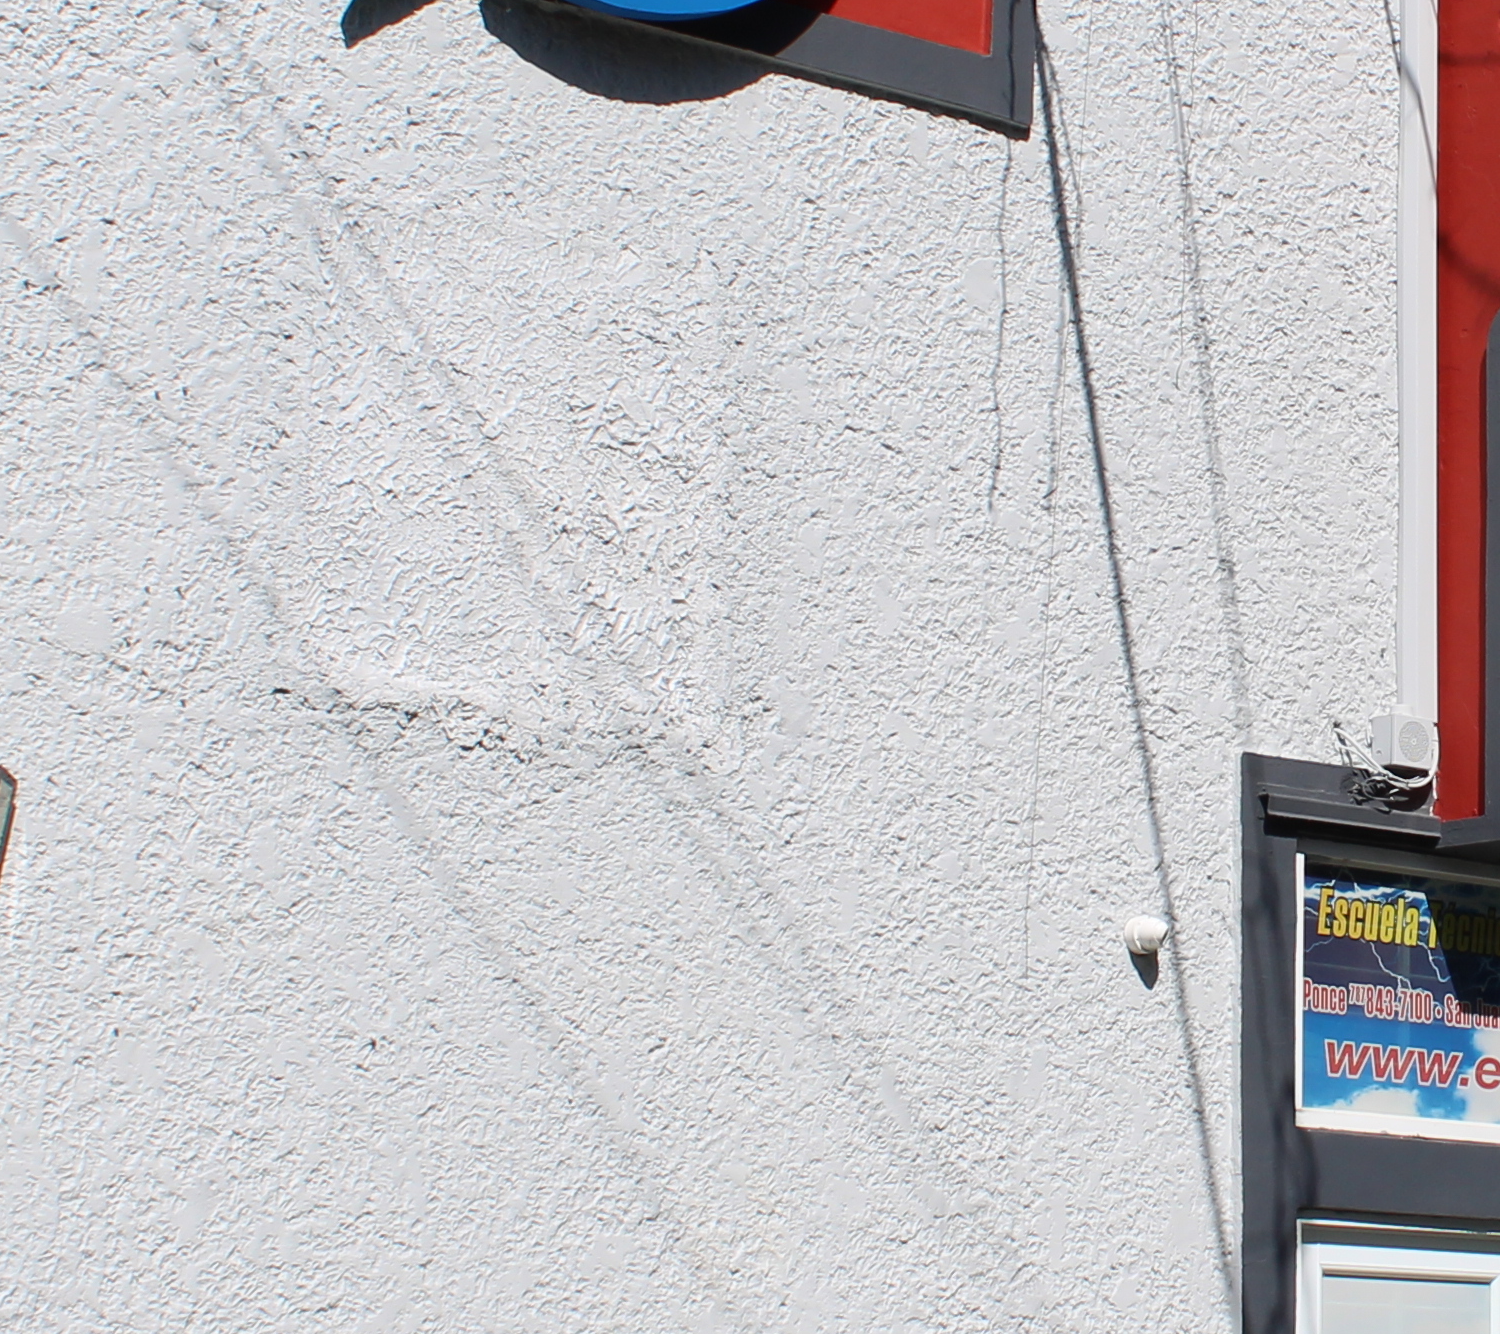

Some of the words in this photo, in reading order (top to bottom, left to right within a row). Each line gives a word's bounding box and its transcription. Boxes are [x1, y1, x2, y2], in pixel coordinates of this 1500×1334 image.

[1316, 886, 1420, 949] Escuela
[1303, 977, 1347, 1014] Ponce
[1365, 985, 1433, 1024] 843-7100
[1444, 992, 1472, 1027] San
